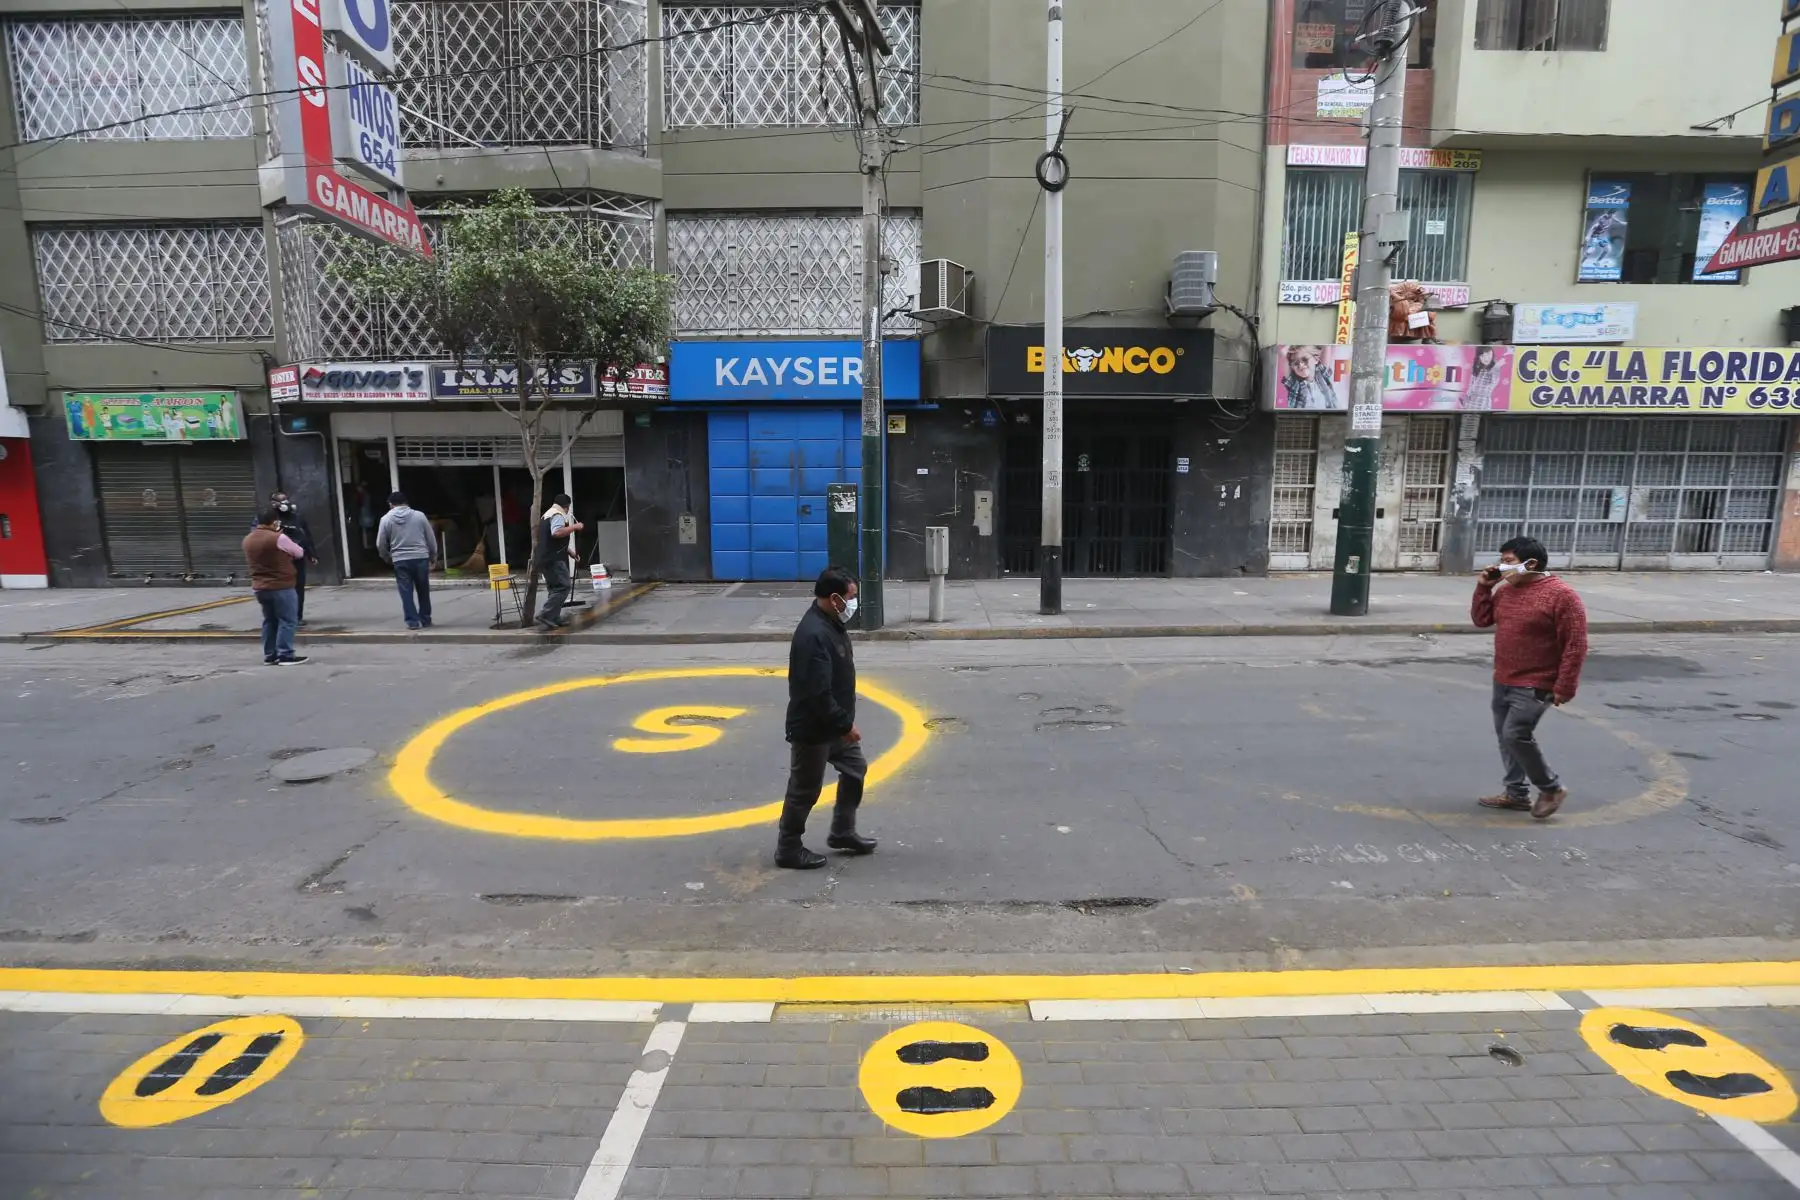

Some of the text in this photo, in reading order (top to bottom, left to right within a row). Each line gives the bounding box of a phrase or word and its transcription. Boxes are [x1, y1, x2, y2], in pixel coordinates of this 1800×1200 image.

[360, 132, 397, 177] 654
[1291, 147, 1315, 163] TELAS
[1324, 148, 1351, 164] MAYOR
[1412, 150, 1452, 167] CORTINAS
[1454, 160, 1478, 169] 205
[316, 175, 422, 249] GAMARRA
[1283, 293, 1312, 302] 205
[1314, 286, 1340, 302] CORT
[604, 366, 666, 381] FSTER
[715, 357, 863, 386] KAYSER
[1518, 350, 1580, 382] C.C.
[1661, 351, 1800, 382] FLORIDA
[1531, 385, 1690, 407] GAMARRA
[1748, 386, 1800, 408] 638
